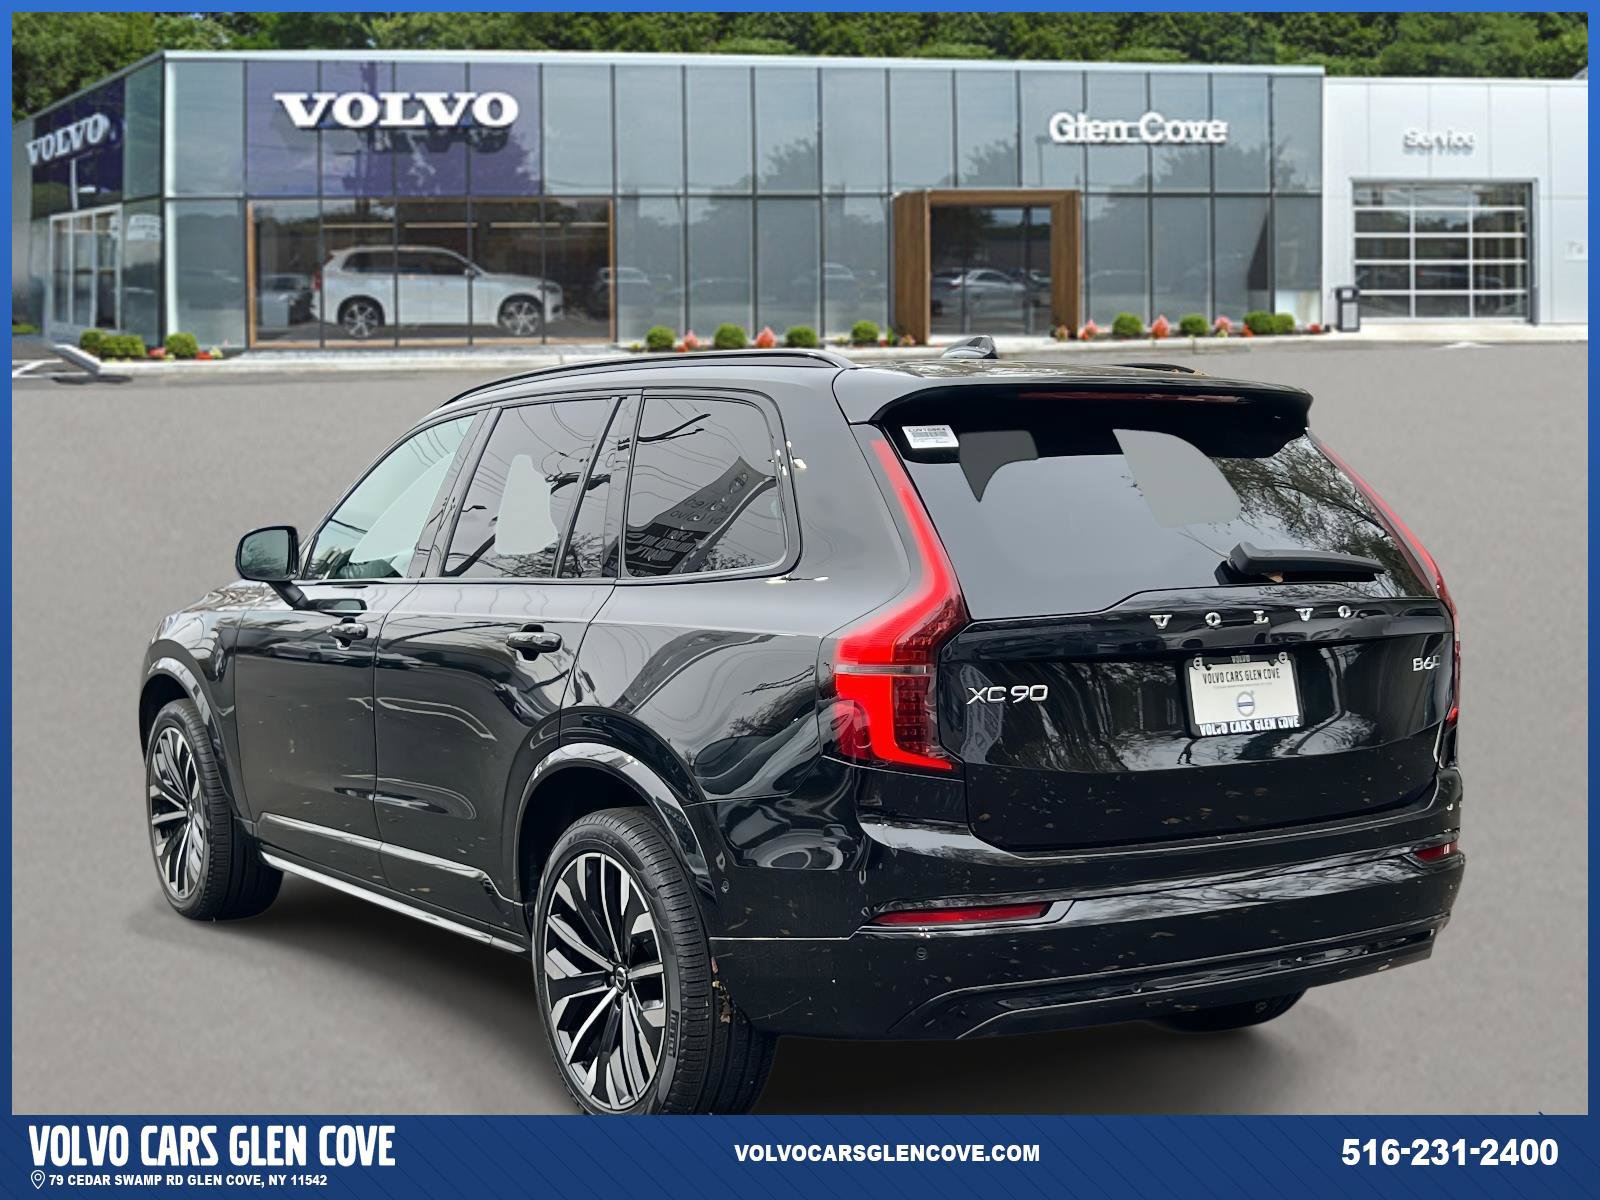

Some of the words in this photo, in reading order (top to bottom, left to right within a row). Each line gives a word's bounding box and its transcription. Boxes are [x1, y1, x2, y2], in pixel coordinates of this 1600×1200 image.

[274, 92, 519, 127] VOLVO
[25, 112, 110, 165] VOLVO
[1049, 111, 1131, 143] Glen
[1139, 111, 1229, 143] Cove
[1403, 127, 1475, 155] Service
[1149, 605, 1352, 630] VOLVO
[1231, 654, 1251, 664] VOLVO
[1203, 672, 1225, 684] VOLVO
[1226, 671, 1243, 682] CARS
[1244, 669, 1262, 681] GLEN
[1263, 667, 1281, 679] COVE
[1229, 720, 1253, 734] CARS
[1253, 718, 1277, 731] GLEN
[1277, 715, 1300, 728] COVE
